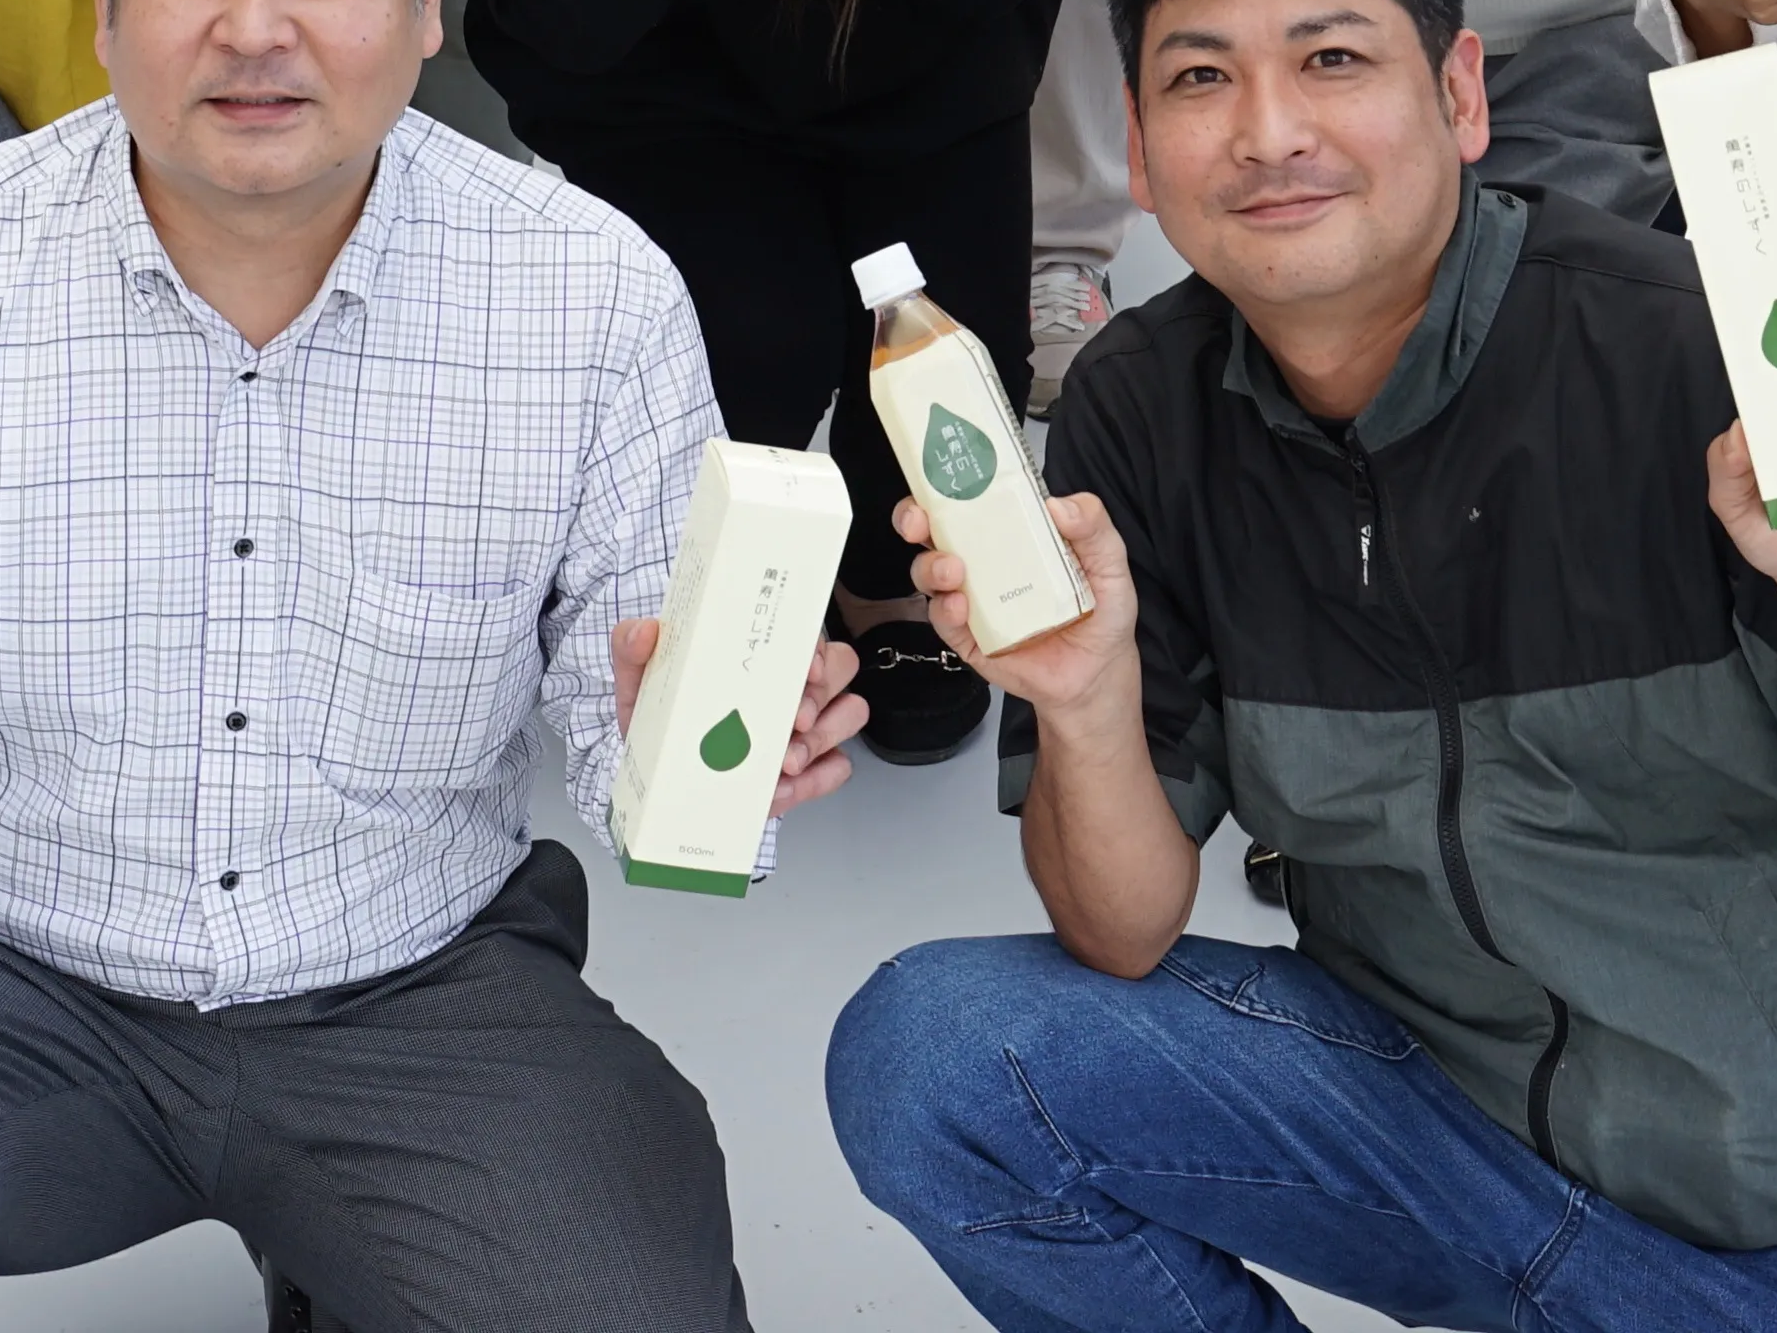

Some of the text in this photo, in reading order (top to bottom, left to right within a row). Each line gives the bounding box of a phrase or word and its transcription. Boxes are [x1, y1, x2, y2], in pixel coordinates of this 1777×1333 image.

[936, 450, 962, 492] しずく
[998, 583, 1034, 604] 500ml
